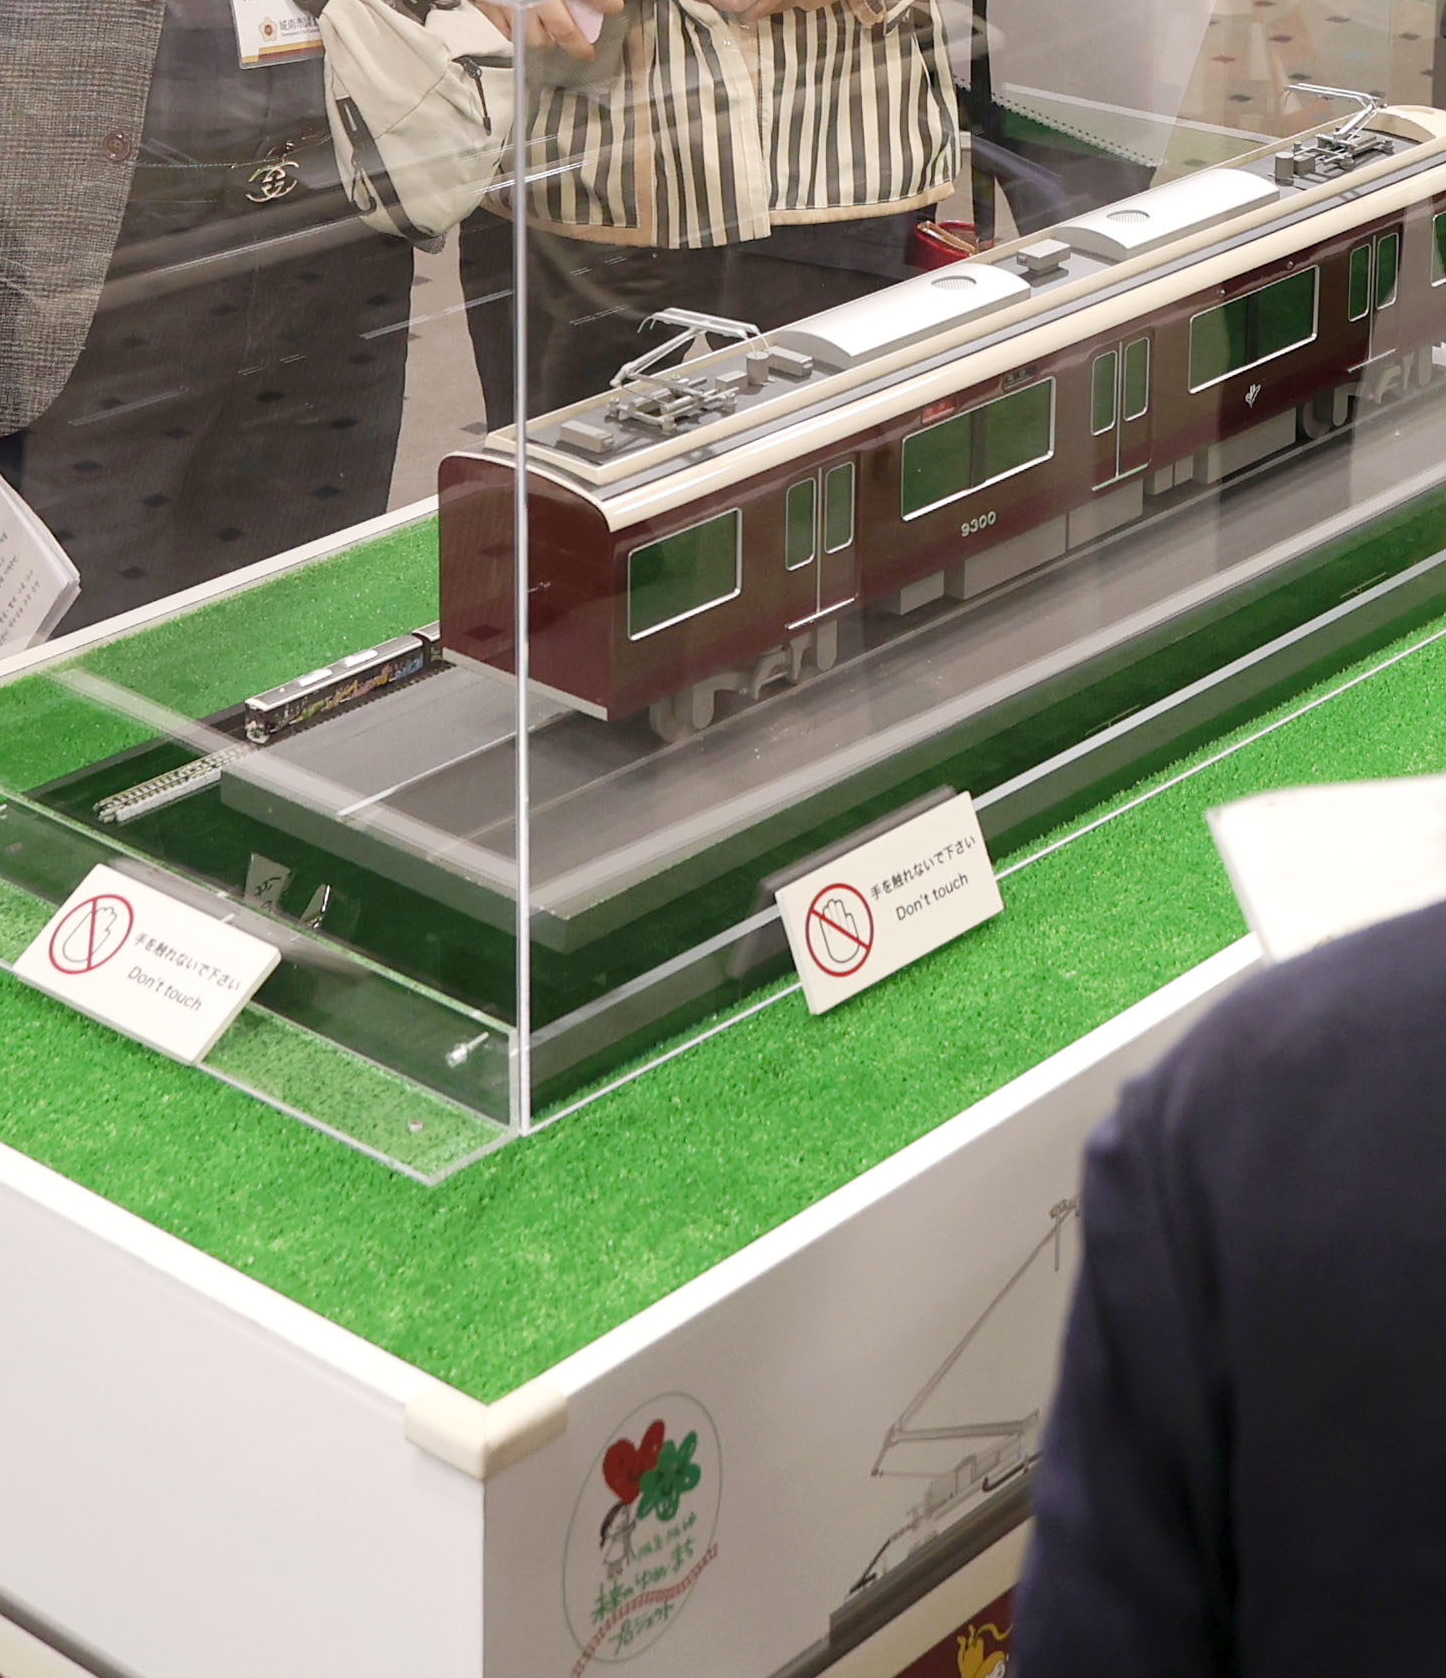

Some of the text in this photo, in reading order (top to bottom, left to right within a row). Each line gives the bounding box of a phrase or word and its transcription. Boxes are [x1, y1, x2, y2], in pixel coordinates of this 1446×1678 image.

[960, 510, 997, 539] 9300
[869, 835, 977, 902] 手を触れないで下さい
[895, 872, 970, 922] Don't touch
[132, 931, 242, 993] 手を触れないで下さい
[127, 964, 204, 1012] Don't touch
